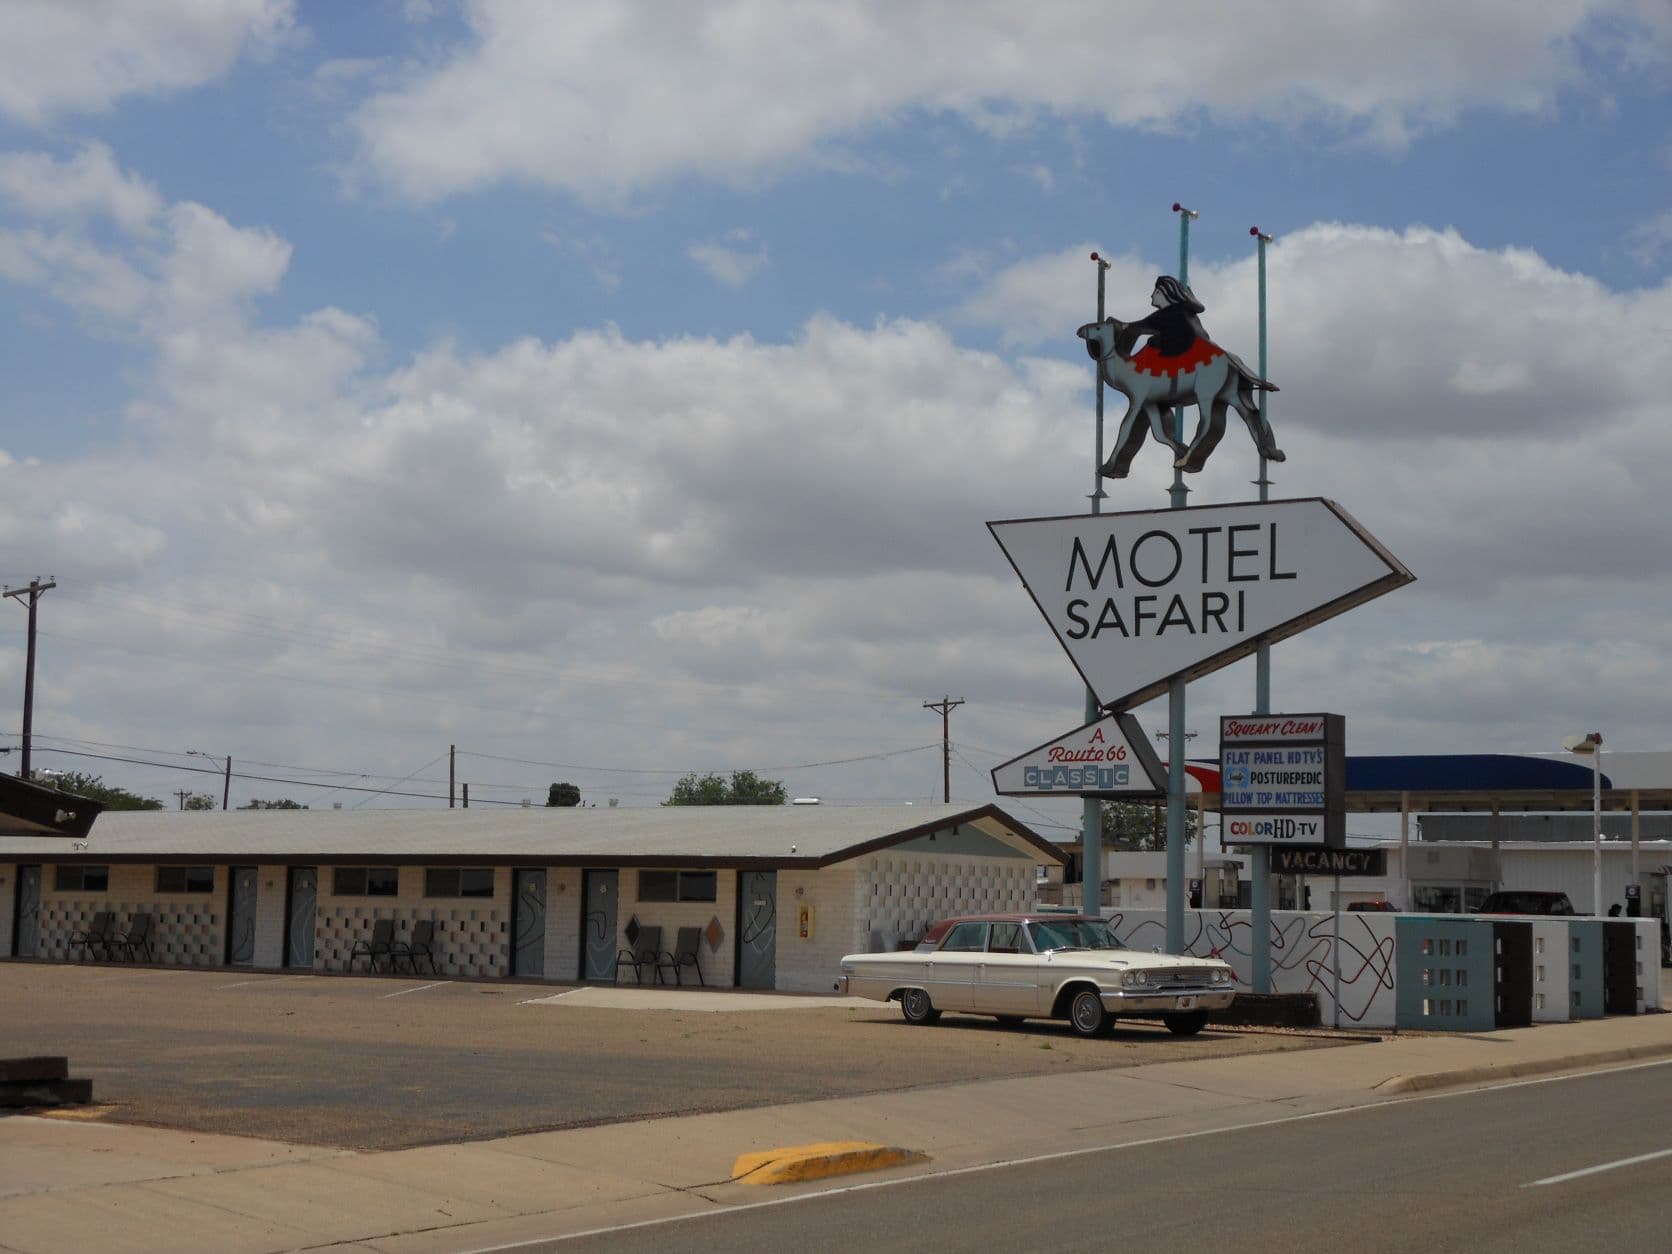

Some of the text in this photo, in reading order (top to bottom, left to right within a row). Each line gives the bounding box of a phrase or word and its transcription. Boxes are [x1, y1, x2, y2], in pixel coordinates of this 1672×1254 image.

[1065, 523, 1297, 592] MOTEL
[1066, 590, 1245, 640] SAFARI
[1088, 728, 1105, 743] A
[1225, 720, 1280, 737] SQUEAKY
[1048, 745, 1126, 762] Route 66
[1226, 751, 1250, 765] FLAT
[1254, 751, 1284, 764] PANEL
[1025, 769, 1128, 786] CLASSIC
[1250, 771, 1322, 785] POSTUREPEDIC
[1223, 791, 1325, 805] PILLOW TOP MATTRESSES
[1281, 850, 1371, 871] VACANCY
